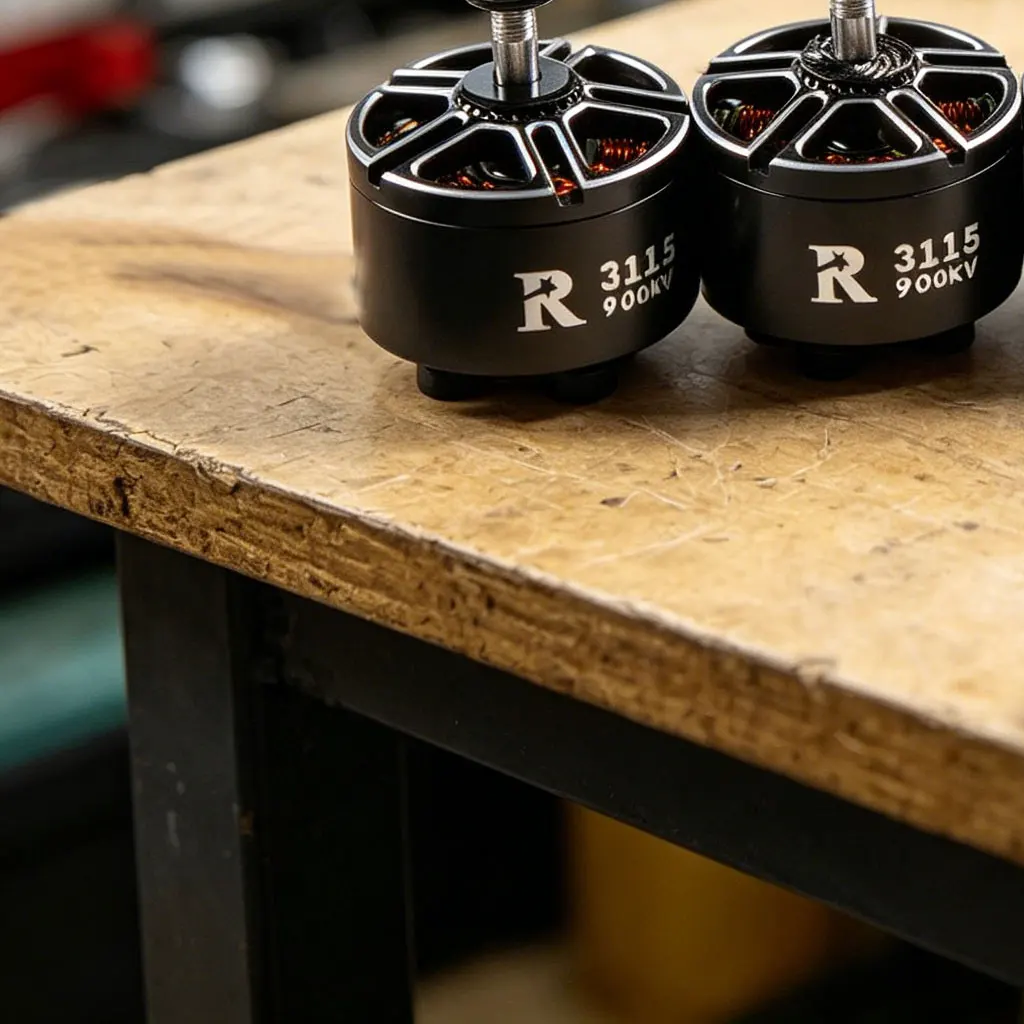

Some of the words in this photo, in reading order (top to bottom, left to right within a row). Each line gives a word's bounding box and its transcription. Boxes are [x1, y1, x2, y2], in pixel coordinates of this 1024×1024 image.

[600, 233, 676, 291] 3115
[808, 244, 878, 304] R
[894, 222, 980, 273] 3115
[514, 269, 587, 332] R
[602, 268, 674, 317] 900KV
[895, 254, 979, 299] 900KV
